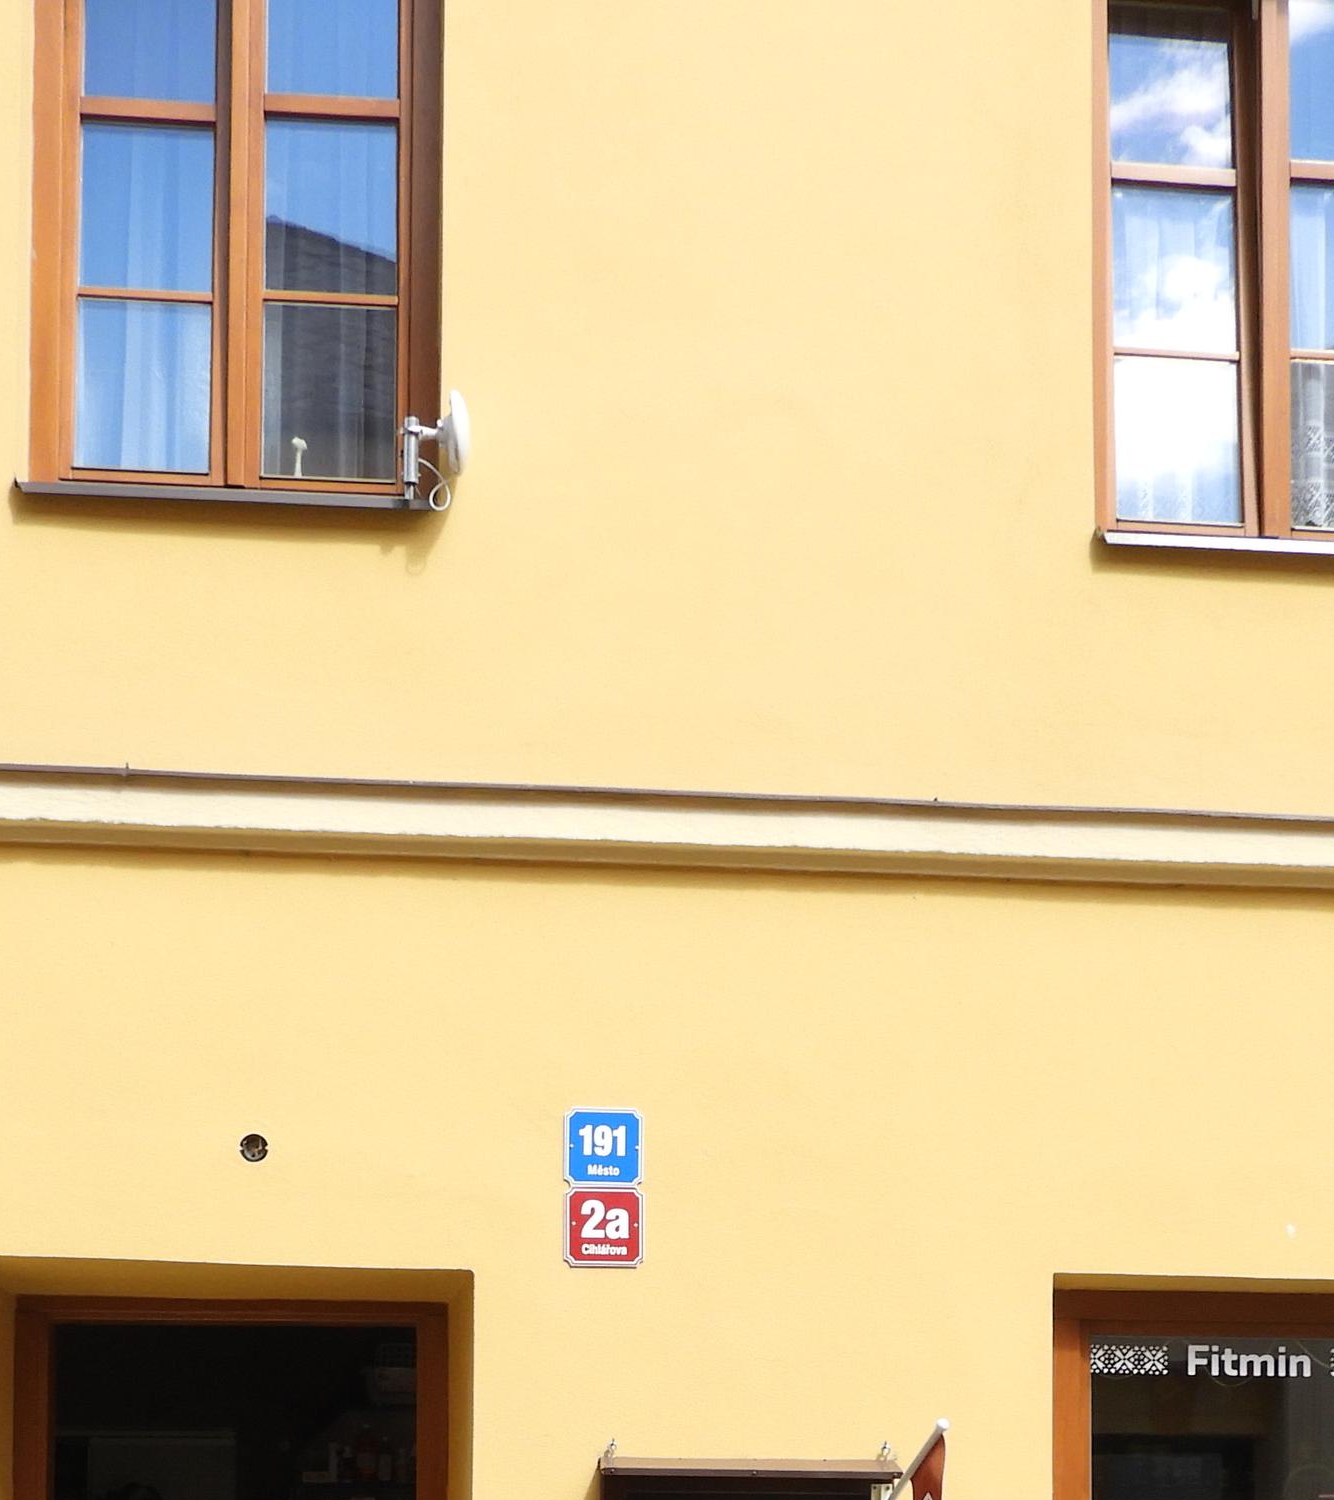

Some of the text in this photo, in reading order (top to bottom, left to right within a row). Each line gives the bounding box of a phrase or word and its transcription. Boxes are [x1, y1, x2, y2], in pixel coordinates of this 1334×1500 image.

[579, 1124, 627, 1157] 191
[587, 1164, 620, 1176] Město
[580, 1199, 630, 1240] 2a
[1187, 1344, 1312, 1378] Fitmin
